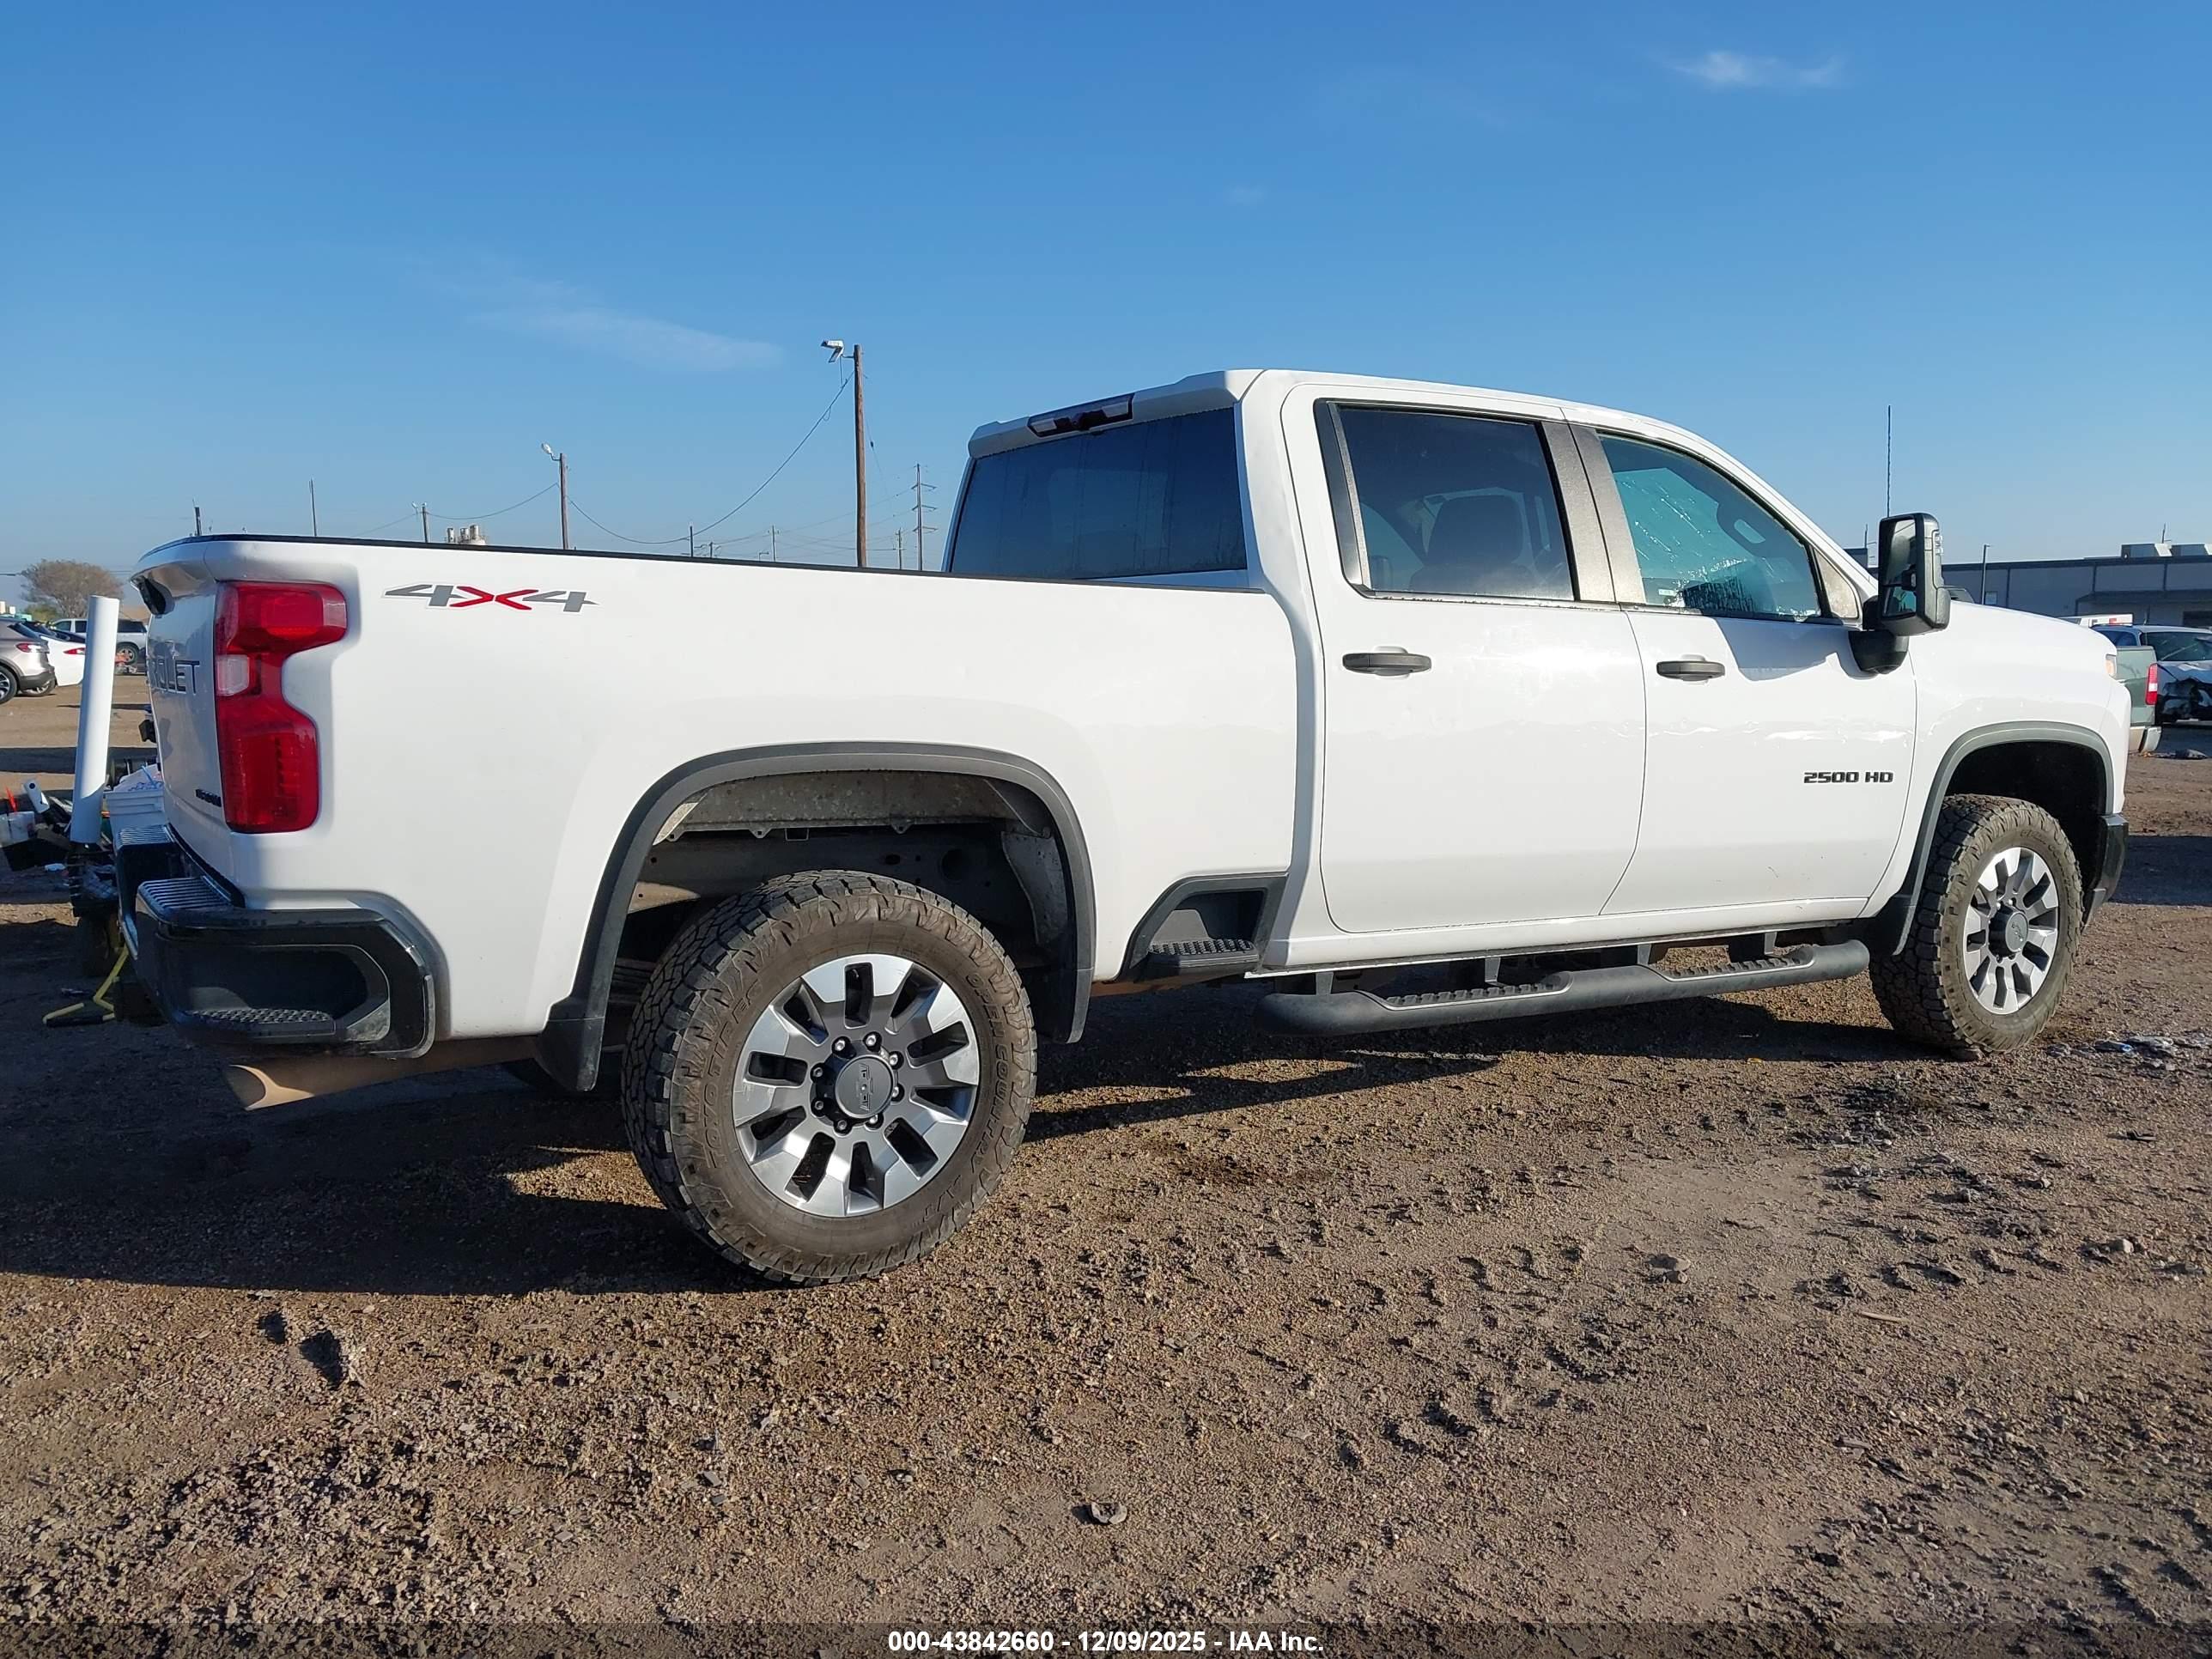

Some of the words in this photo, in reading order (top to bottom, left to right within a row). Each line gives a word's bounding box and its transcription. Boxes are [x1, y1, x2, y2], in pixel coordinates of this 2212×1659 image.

[1803, 771, 1859, 783] 2500
[1864, 771, 1894, 783] HD
[965, 974, 1004, 1037] OPEN
[704, 1083, 727, 1170] TOYO
